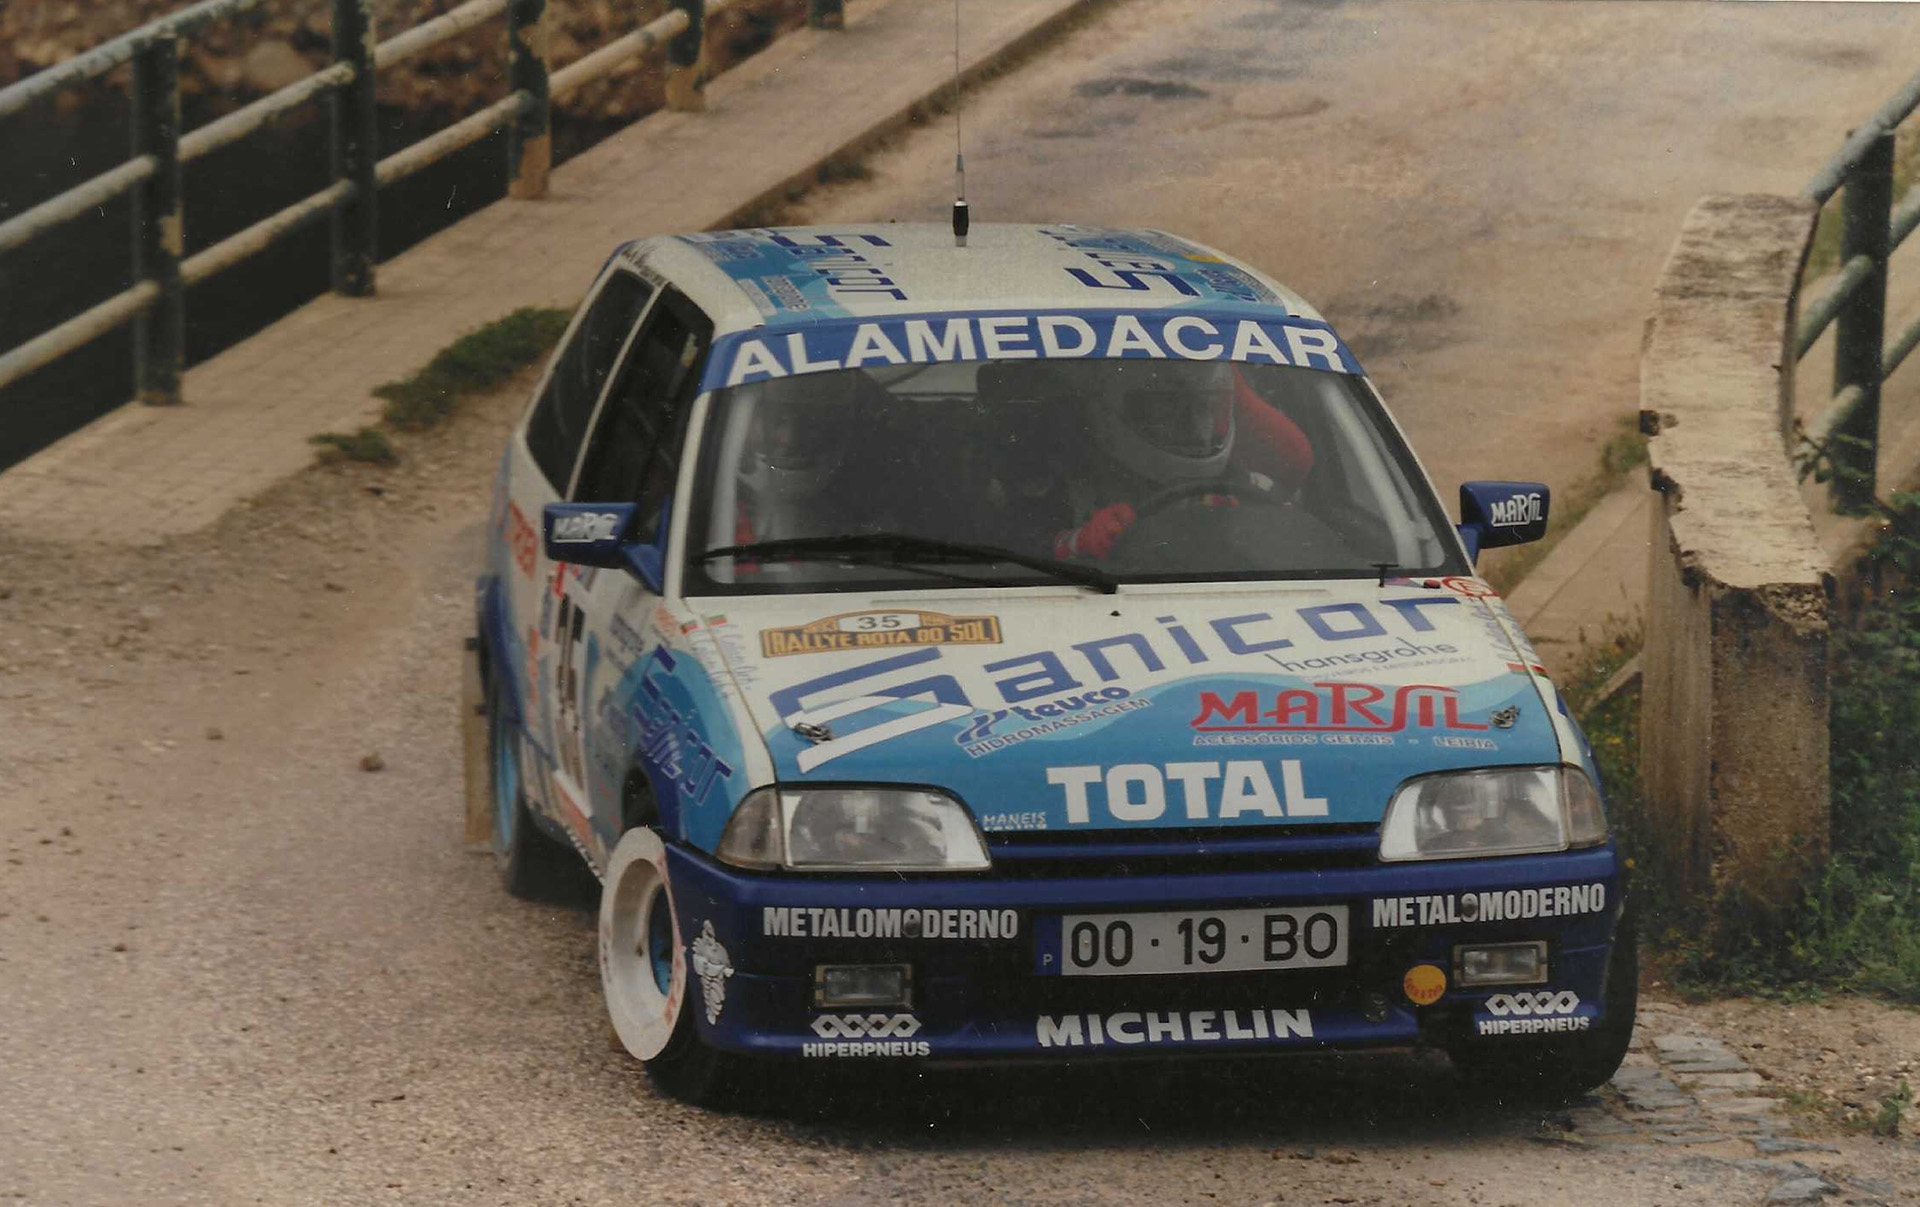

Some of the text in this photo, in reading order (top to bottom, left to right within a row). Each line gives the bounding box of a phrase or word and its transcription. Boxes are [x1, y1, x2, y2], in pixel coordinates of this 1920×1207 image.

[728, 315, 1348, 381] ALAMEDACAR
[773, 621, 991, 655] RALLYE ROTA DO SOL
[857, 614, 901, 630] 35
[1264, 636, 1459, 673] hansgrohe
[768, 596, 1461, 774] Sanicor
[1010, 686, 1131, 721] teuco
[966, 698, 1153, 757] HIDROMASSAGEM
[1322, 734, 1393, 746] GERAIS
[1046, 759, 1329, 825] TOTAL
[1042, 955, 1053, 966] P
[1036, 1009, 1314, 1047] MICHELIN
[1479, 1016, 1590, 1035] HIPERPNEUS
[803, 1041, 931, 1057] HIPERPNEUS
